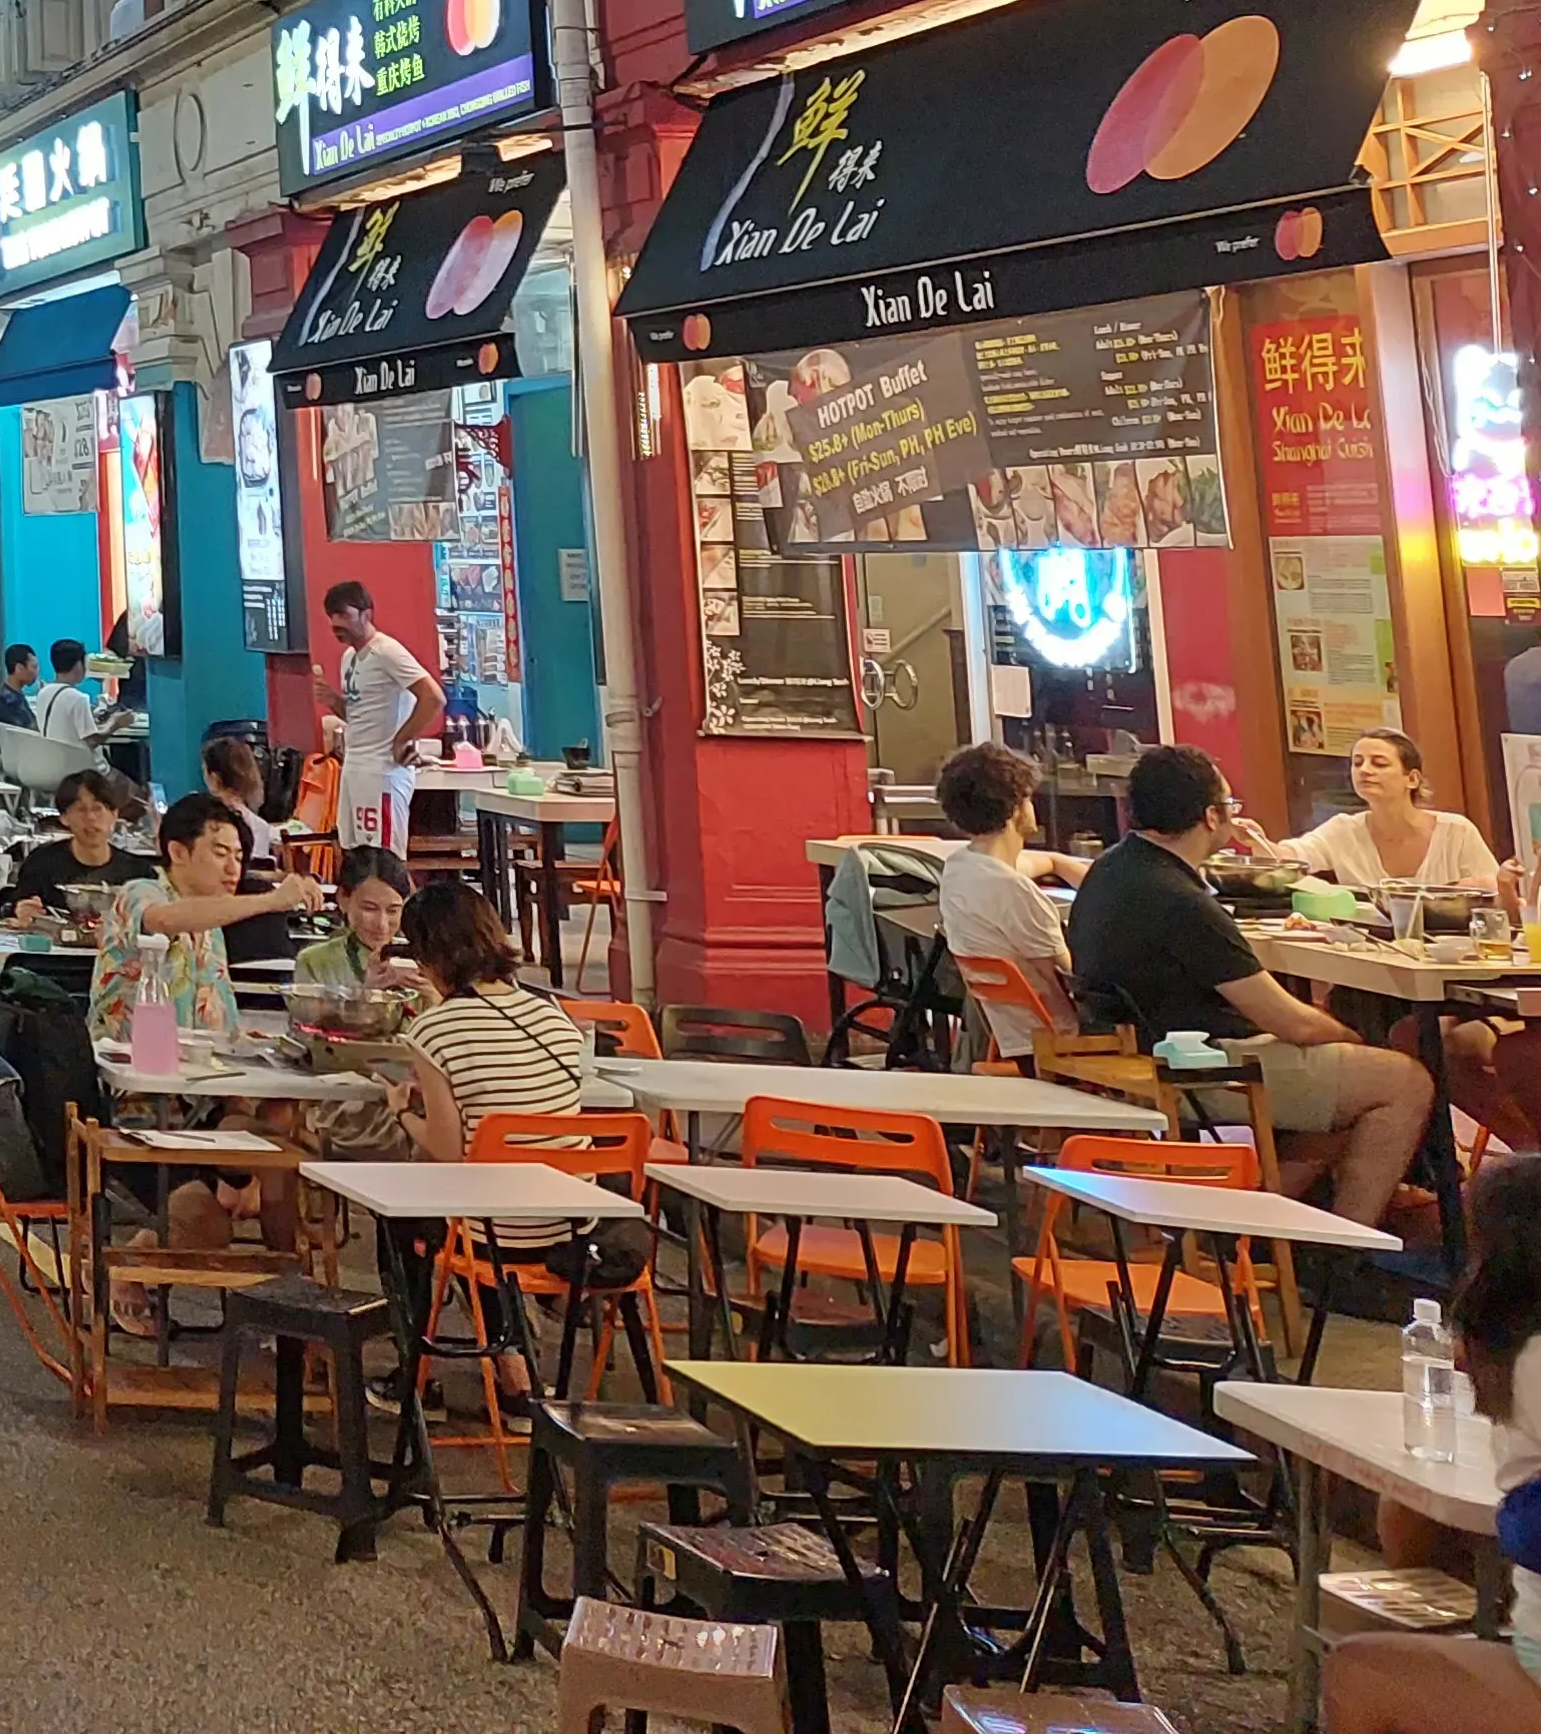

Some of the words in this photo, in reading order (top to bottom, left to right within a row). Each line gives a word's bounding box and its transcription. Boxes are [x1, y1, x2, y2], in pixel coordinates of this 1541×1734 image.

[340, 130, 355, 161] De
[356, 123, 376, 156] Lai
[776, 68, 866, 218] 鲜
[714, 220, 778, 266] Xian
[778, 207, 826, 254] De
[830, 199, 886, 245] Lai
[364, 298, 399, 333] Lai
[860, 283, 913, 328] Xian
[916, 275, 949, 318] De
[954, 269, 996, 314] Lai
[354, 366, 378, 395] Xian
[380, 360, 394, 391] De
[398, 359, 416, 388] Lai
[817, 383, 874, 429] HOTPOT
[879, 359, 929, 400] Buffet
[808, 433, 849, 464] $25.8+
[850, 398, 926, 450] (Mon-Thurs)
[847, 445, 900, 486] (Fri-Sun,
[899, 436, 925, 462] PH,
[925, 424, 946, 447] PH
[948, 410, 977, 441] Eve)
